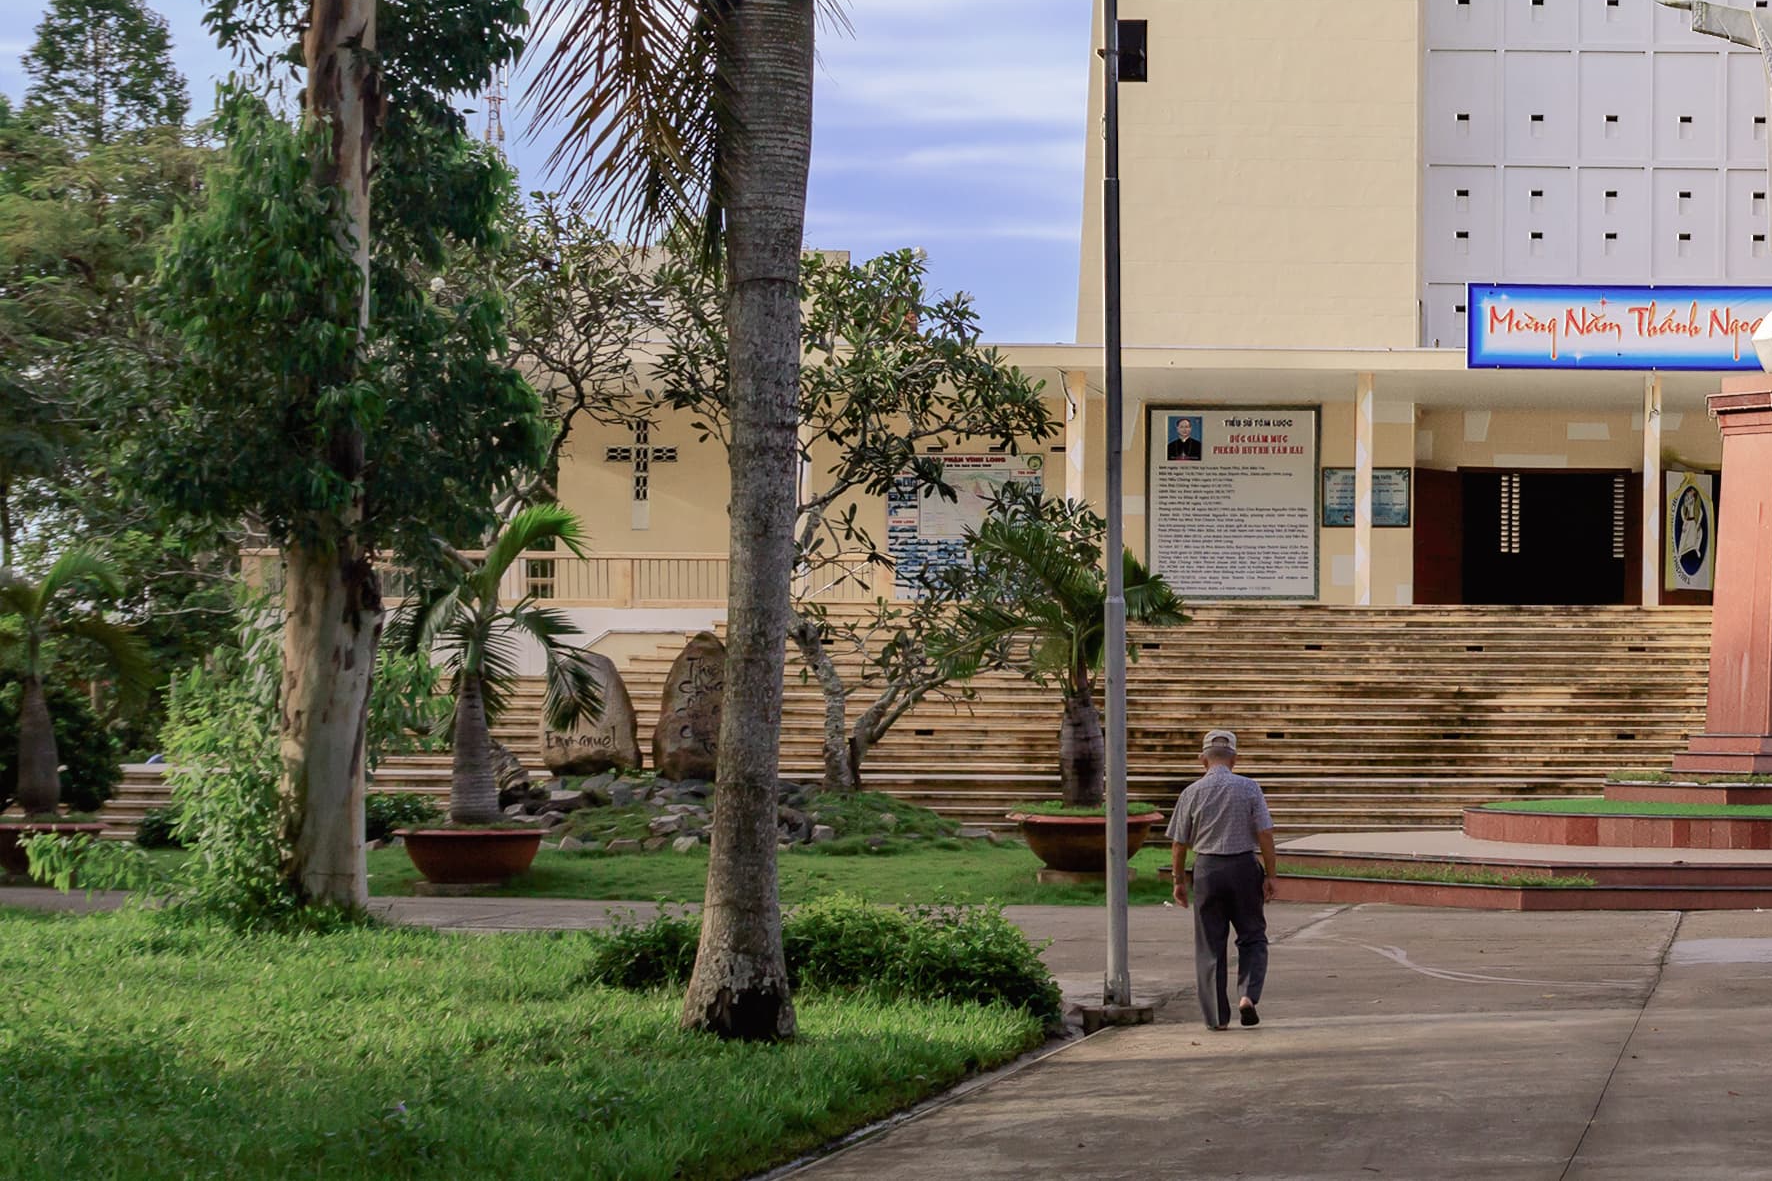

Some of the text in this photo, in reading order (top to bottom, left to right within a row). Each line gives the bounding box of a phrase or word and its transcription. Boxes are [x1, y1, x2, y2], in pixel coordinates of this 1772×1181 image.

[1488, 304, 1557, 360] Mừng
[1564, 305, 1622, 342] Năm
[1627, 299, 1702, 338] Thánh
[545, 726, 617, 750] Emmanuel
